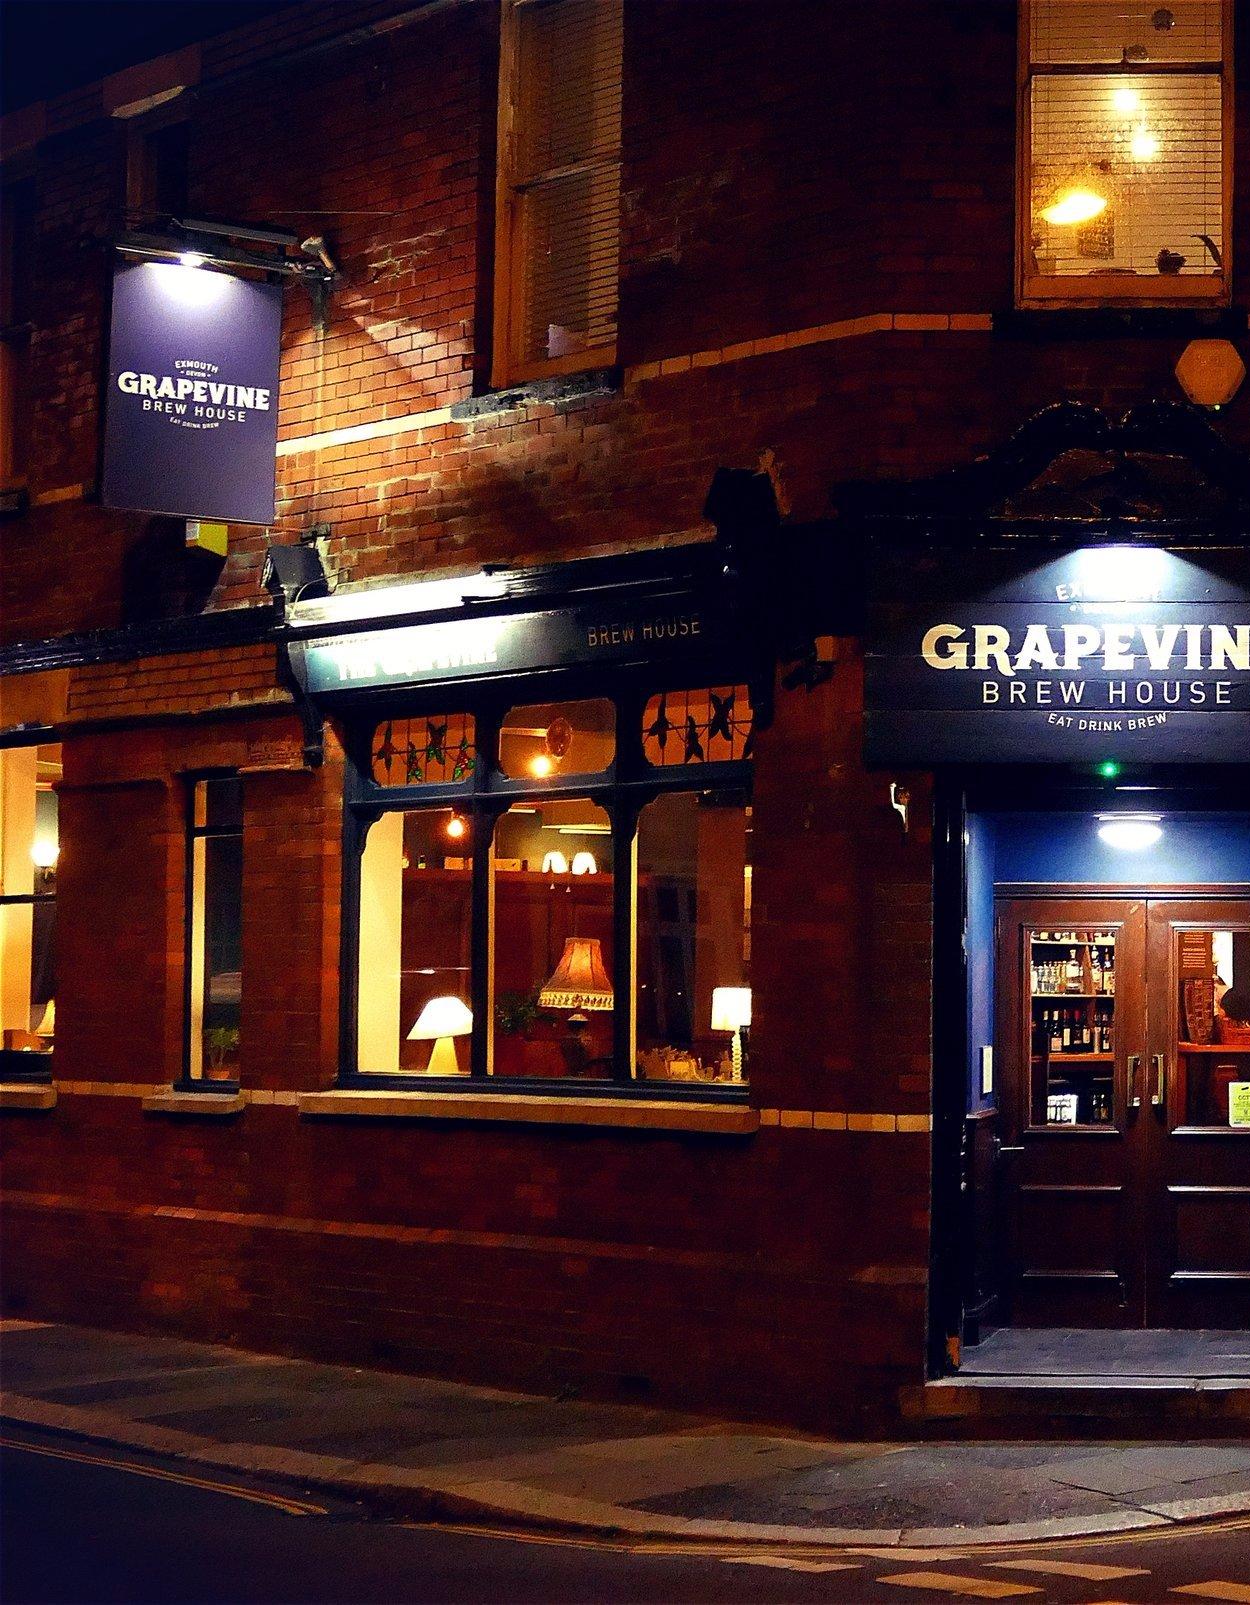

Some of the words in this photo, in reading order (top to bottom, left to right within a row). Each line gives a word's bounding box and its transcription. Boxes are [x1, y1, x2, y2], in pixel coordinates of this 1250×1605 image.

[174, 360, 219, 374] EXMOUTH
[118, 371, 270, 411] GRAPEVINE
[142, 399, 187, 415] BREW
[194, 405, 247, 422] HOUSE
[169, 416, 181, 425] EAT
[181, 421, 201, 429] DRINK
[587, 623, 637, 647] BREW
[642, 614, 701, 639] HOUSE
[982, 680, 1086, 704] BREW
[1109, 680, 1232, 704] HOUSE
[1048, 713, 1074, 728] EAT
[1078, 719, 1122, 731] DRINK
[1128, 713, 1167, 730] BREW
